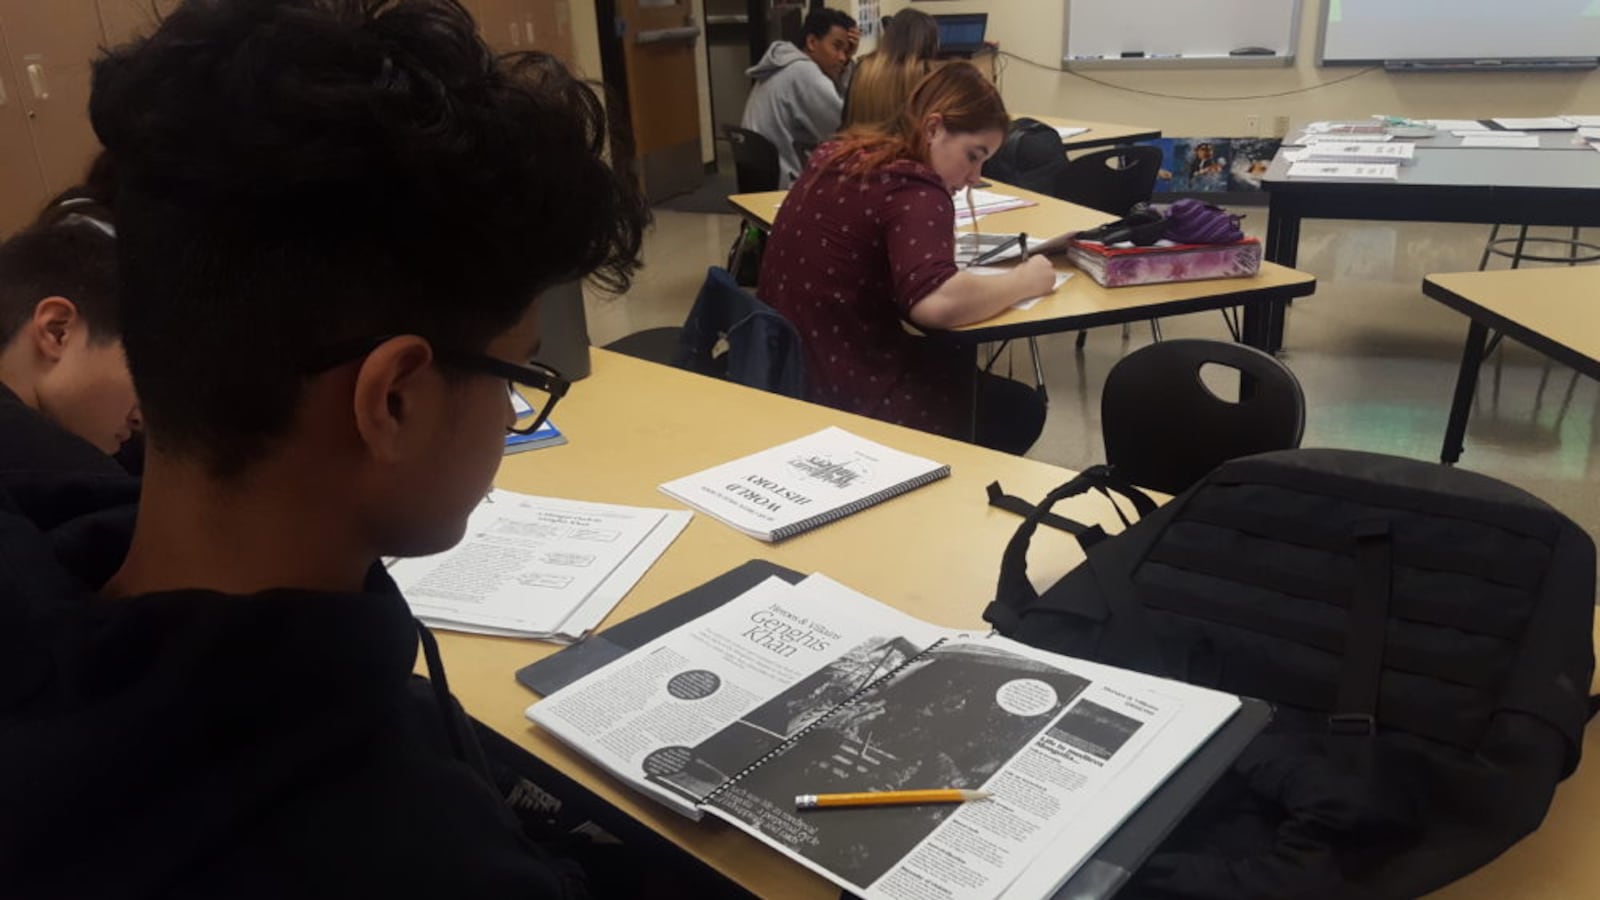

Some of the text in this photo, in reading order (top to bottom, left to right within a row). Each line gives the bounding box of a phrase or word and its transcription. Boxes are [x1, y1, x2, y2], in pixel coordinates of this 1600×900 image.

[724, 483, 782, 513] WORLD
[745, 474, 814, 506] HISTORY
[750, 609, 831, 653] Genghis
[768, 602, 798, 622] Heroes
[808, 620, 841, 641] Villains
[741, 625, 798, 658] Khan
